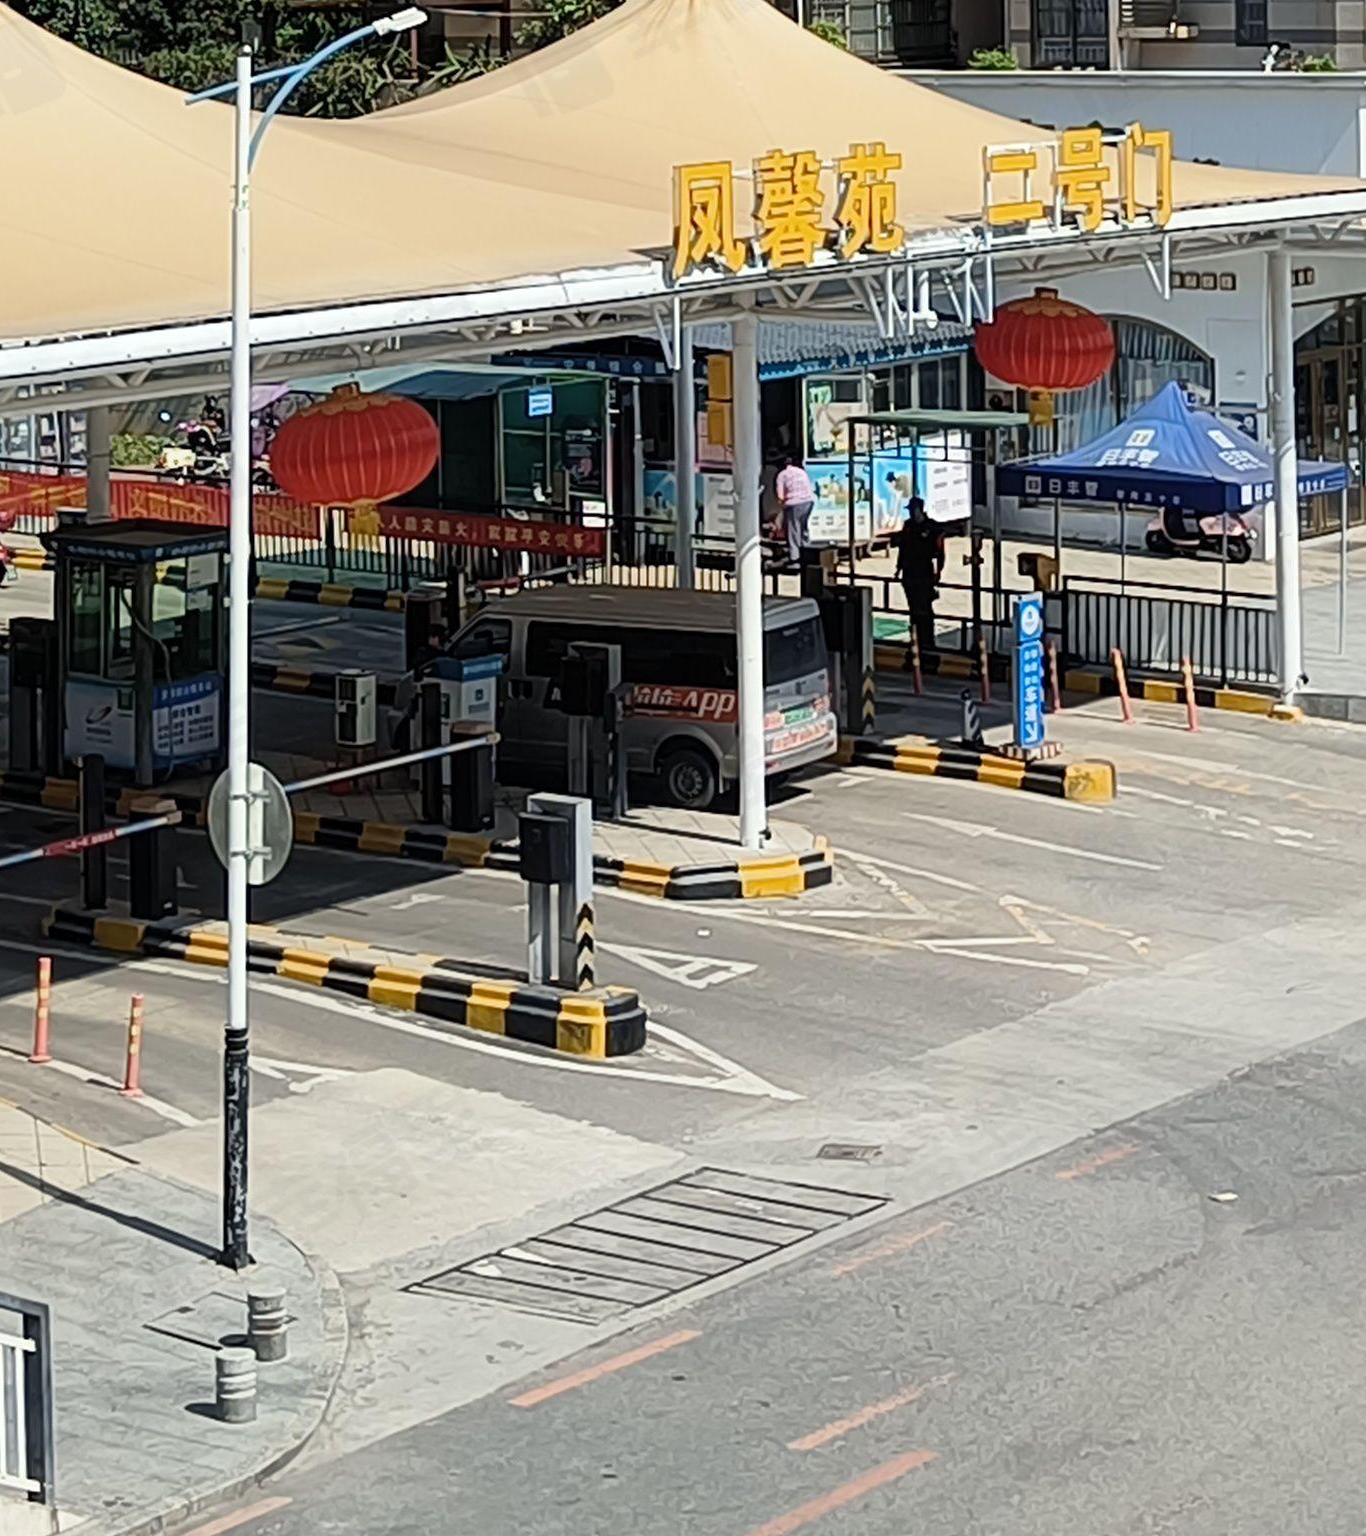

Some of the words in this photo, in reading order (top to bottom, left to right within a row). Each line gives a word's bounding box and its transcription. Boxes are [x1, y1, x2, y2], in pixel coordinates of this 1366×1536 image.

[671, 140, 906, 279] 凤馨苑
[983, 122, 1174, 233] 二号门
[682, 690, 735, 720] App
